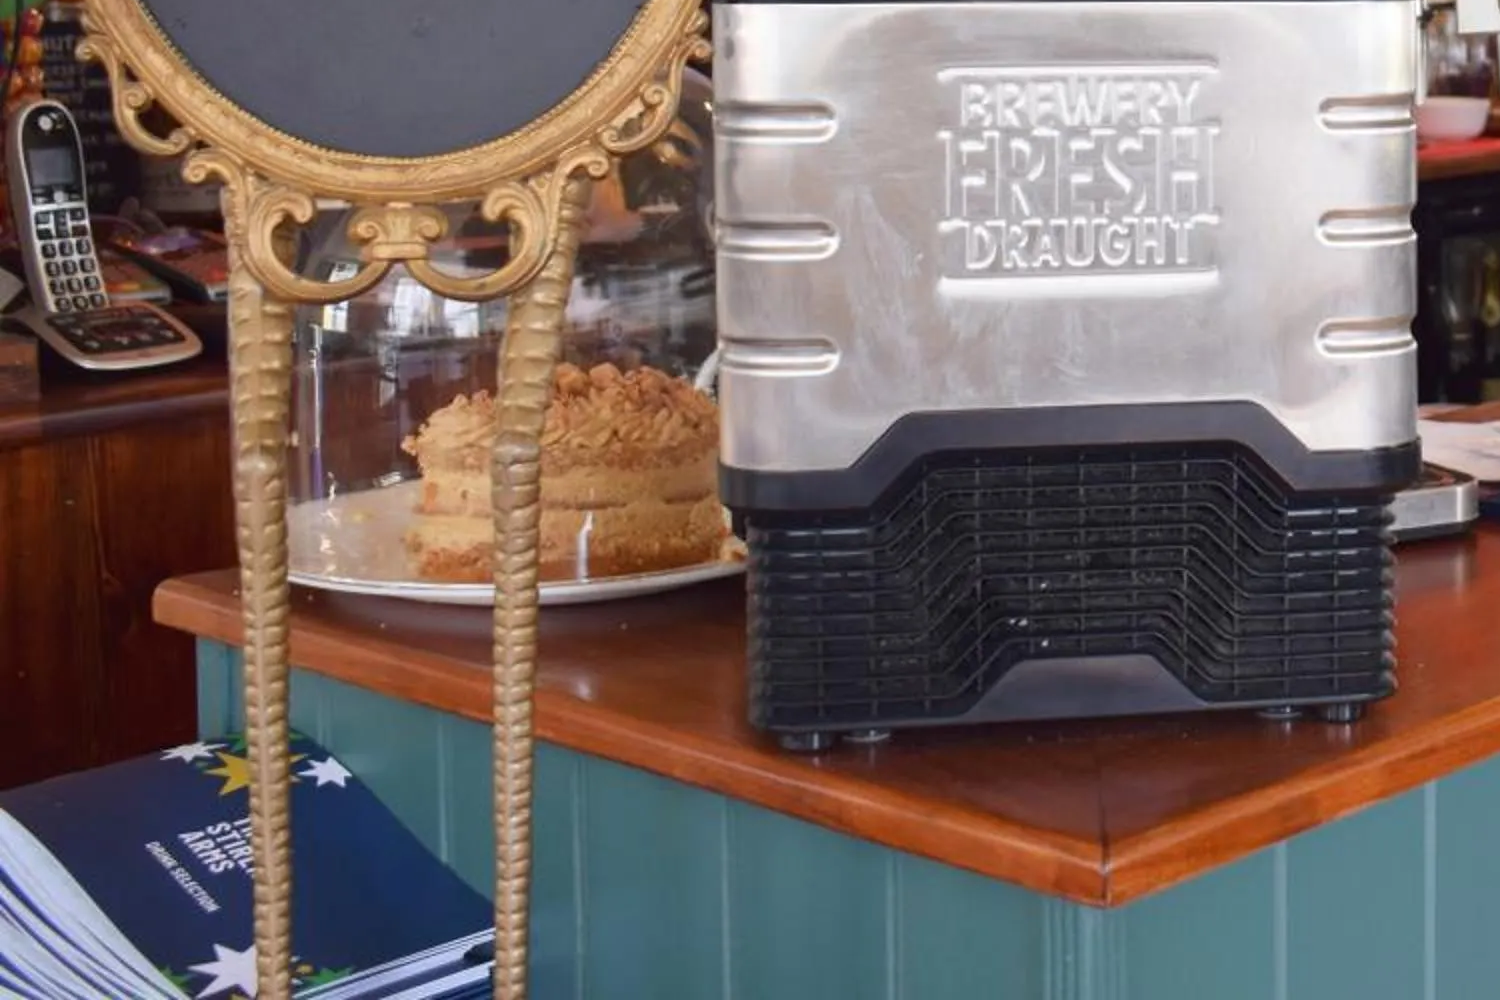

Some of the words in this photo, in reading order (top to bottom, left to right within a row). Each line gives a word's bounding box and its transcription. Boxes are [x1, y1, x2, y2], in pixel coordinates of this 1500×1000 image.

[960, 78, 1202, 128] BREWERY
[937, 127, 1220, 231] FRESH
[965, 217, 1192, 270] DRAUGHT
[177, 831, 236, 874] ARMS
